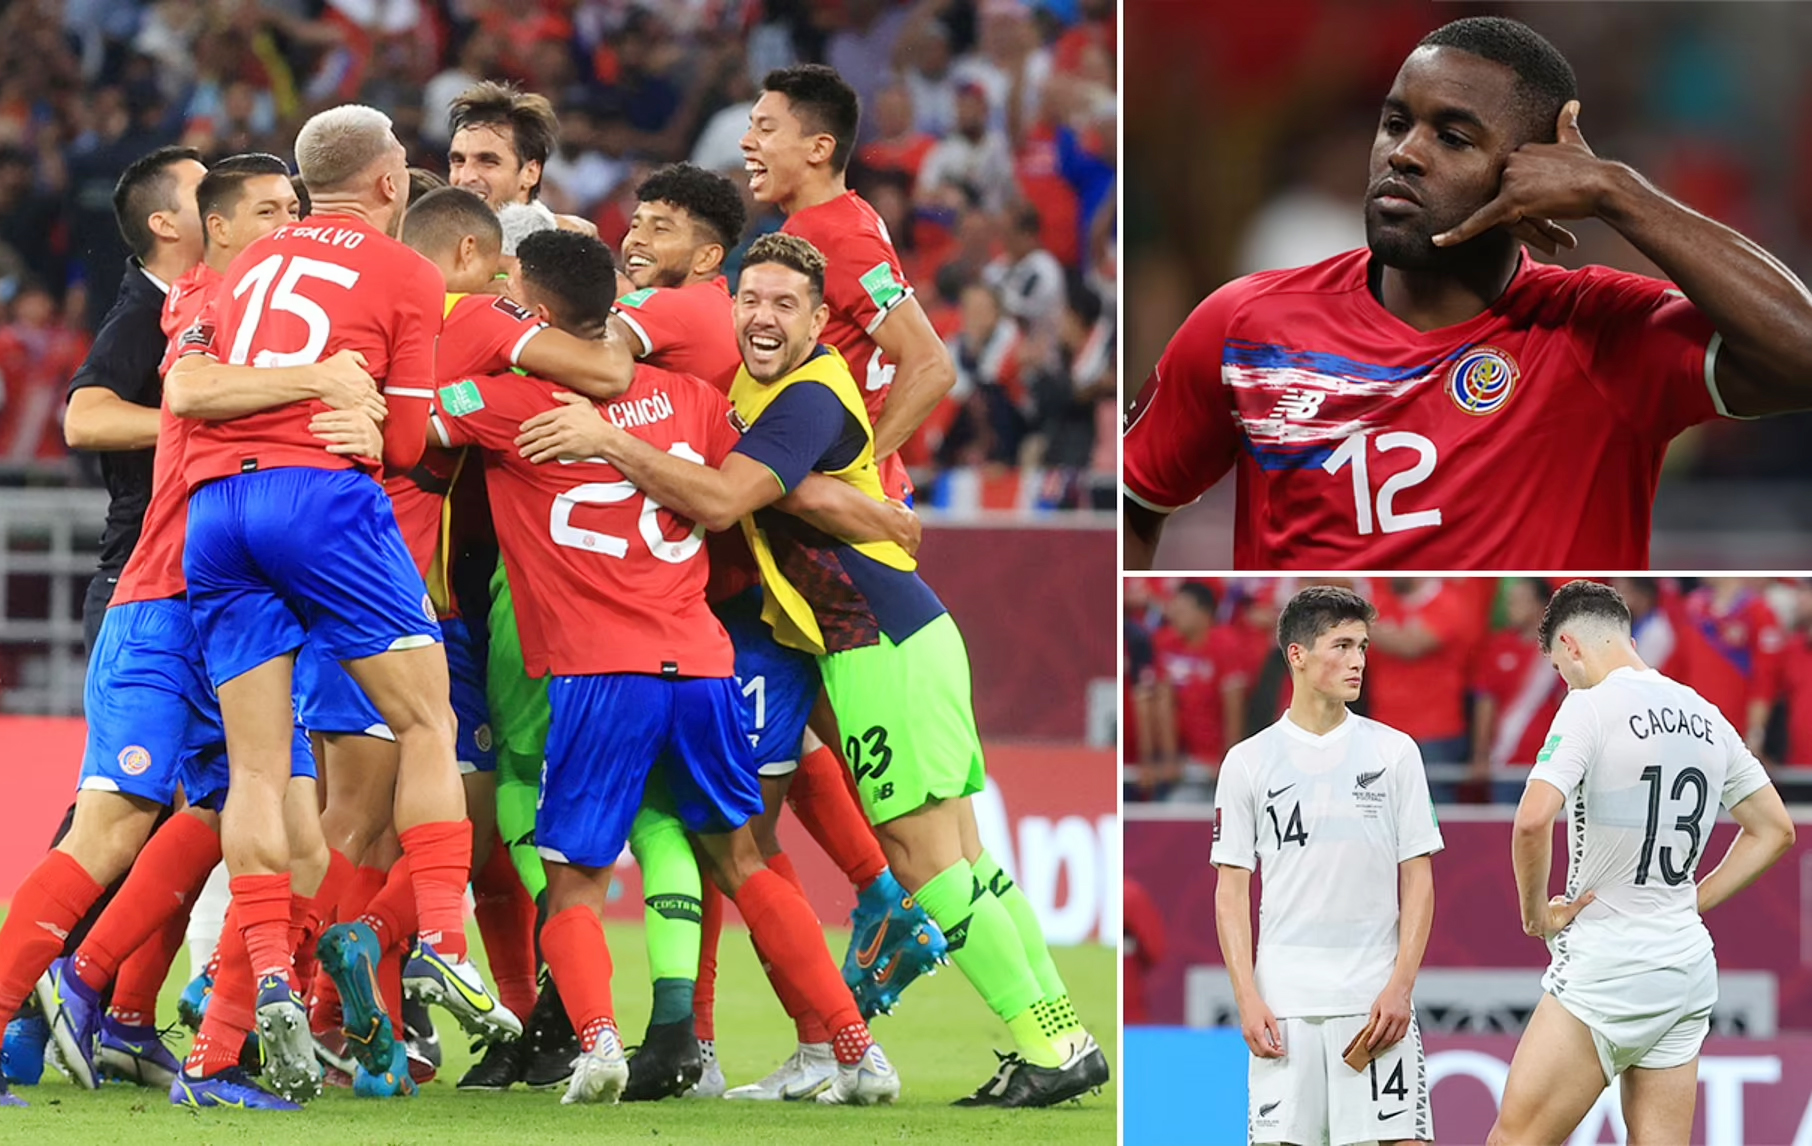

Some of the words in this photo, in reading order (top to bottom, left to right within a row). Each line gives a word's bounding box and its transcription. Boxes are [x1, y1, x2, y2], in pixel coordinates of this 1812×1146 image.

[228, 253, 361, 369] 15
[1321, 431, 1442, 535] 12
[846, 725, 893, 786] 23
[1629, 707, 1715, 745] CACACE
[1266, 800, 1309, 850] 14
[1634, 765, 1708, 886] 13
[1370, 1056, 1409, 1101] 14
